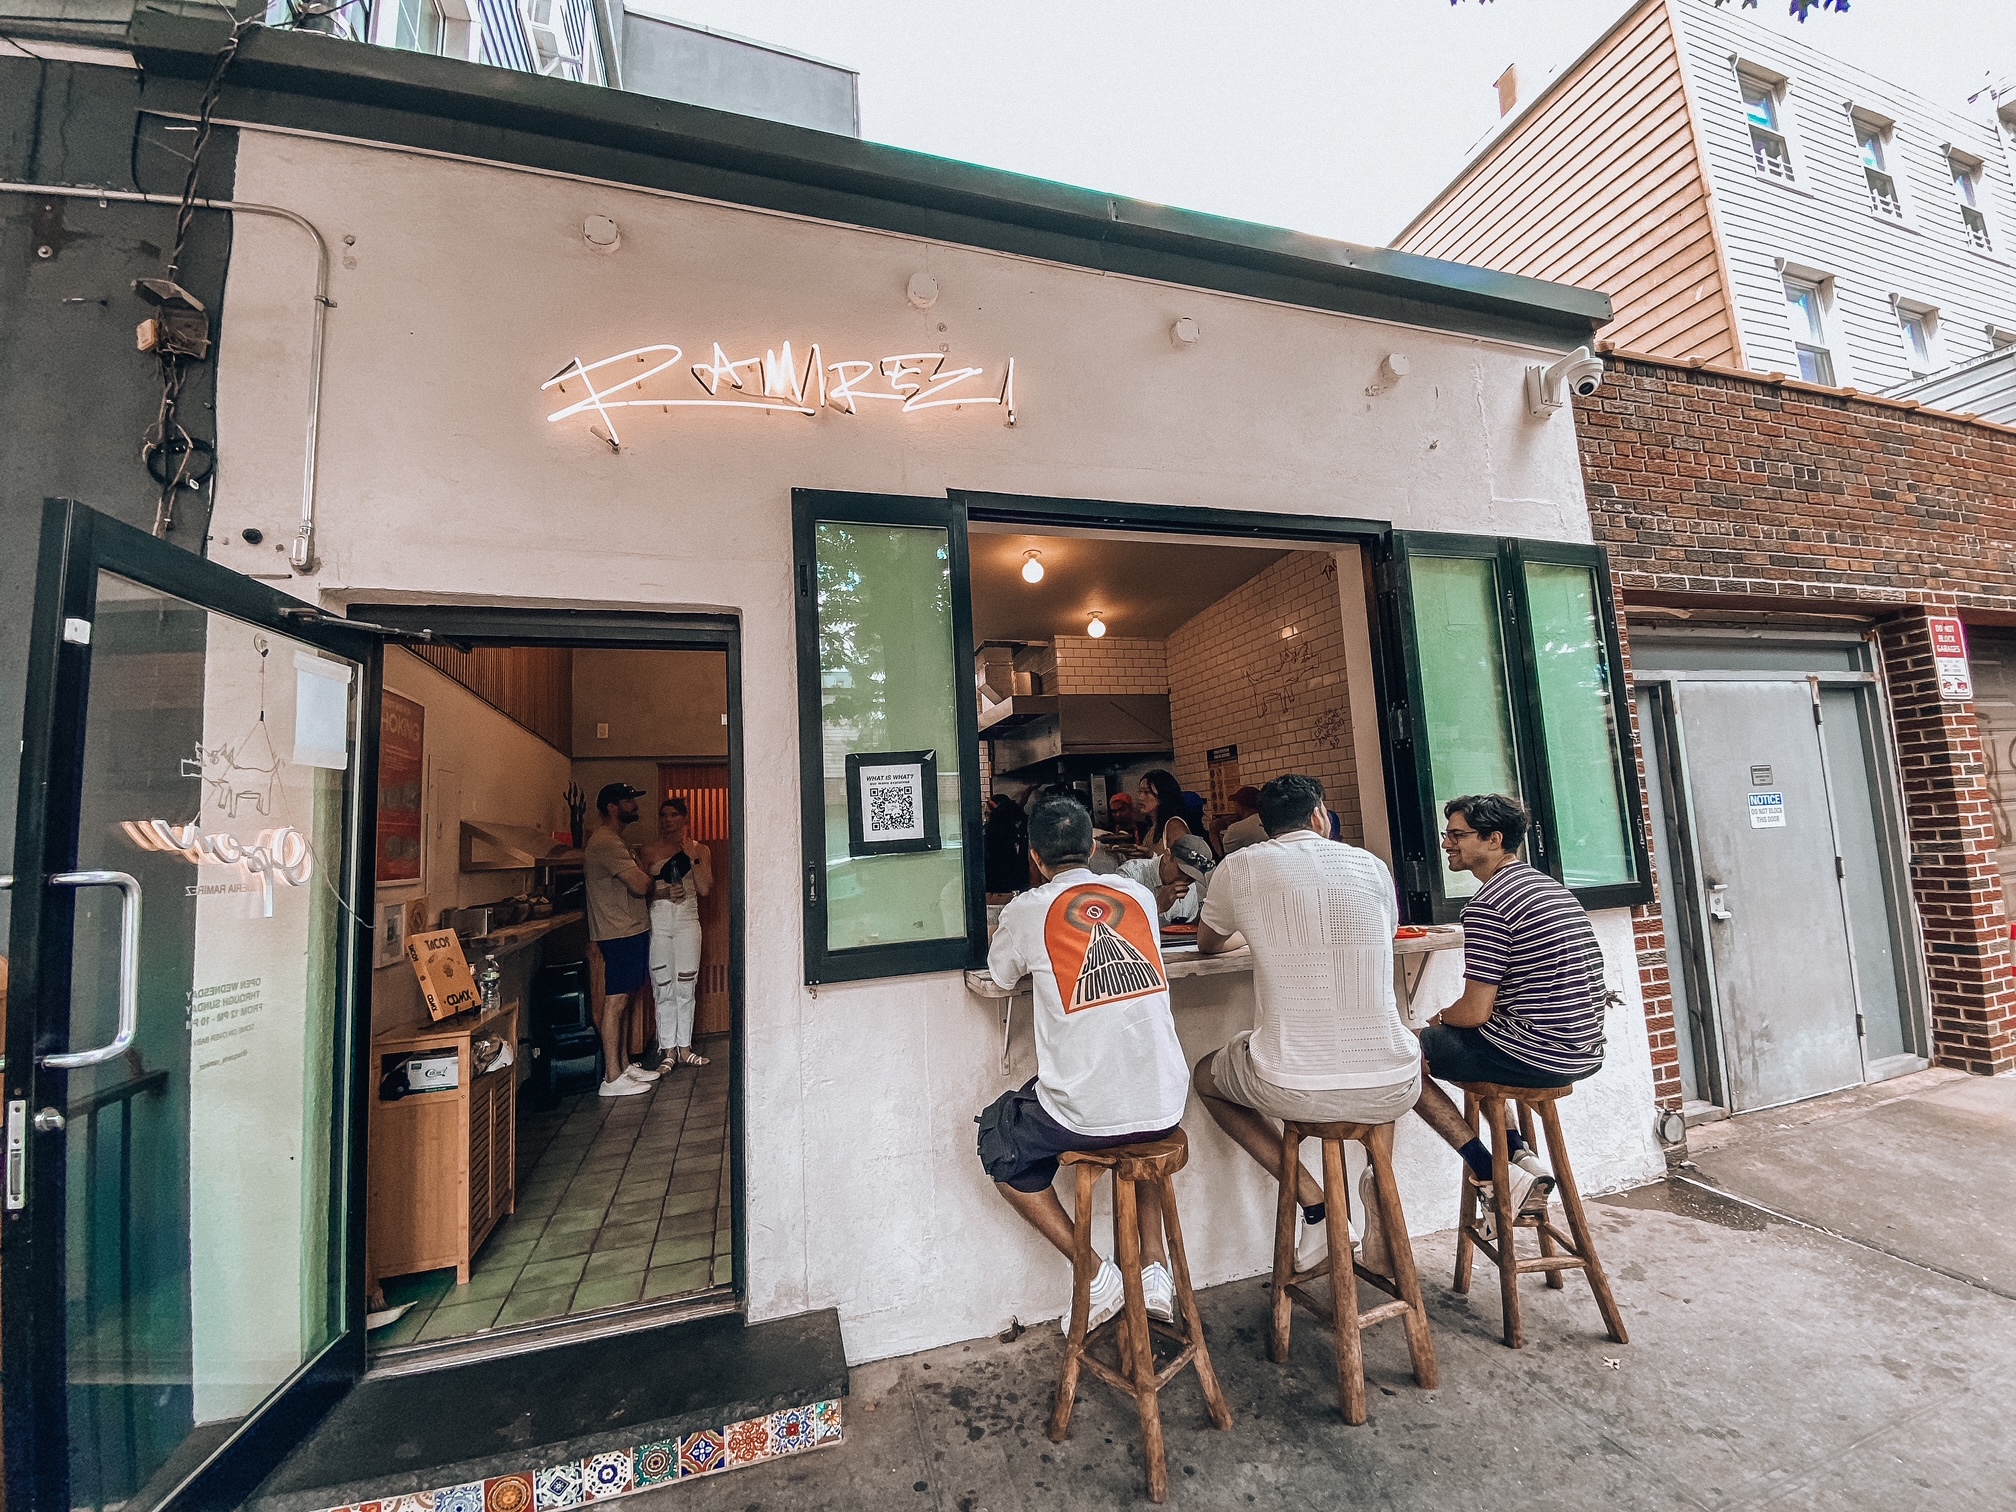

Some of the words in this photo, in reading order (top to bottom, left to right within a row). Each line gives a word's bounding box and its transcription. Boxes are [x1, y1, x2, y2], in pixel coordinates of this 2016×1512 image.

[1935, 624, 1943, 632] DO
[382, 710, 420, 742] HOKING
[1750, 795, 1780, 805] NOTICE
[424, 936, 450, 951] TACOS
[408, 944, 419, 962] TACOS
[1082, 935, 1126, 975] SOUND
[1116, 938, 1144, 962] OF
[1076, 962, 1161, 1005] TOMORROW
